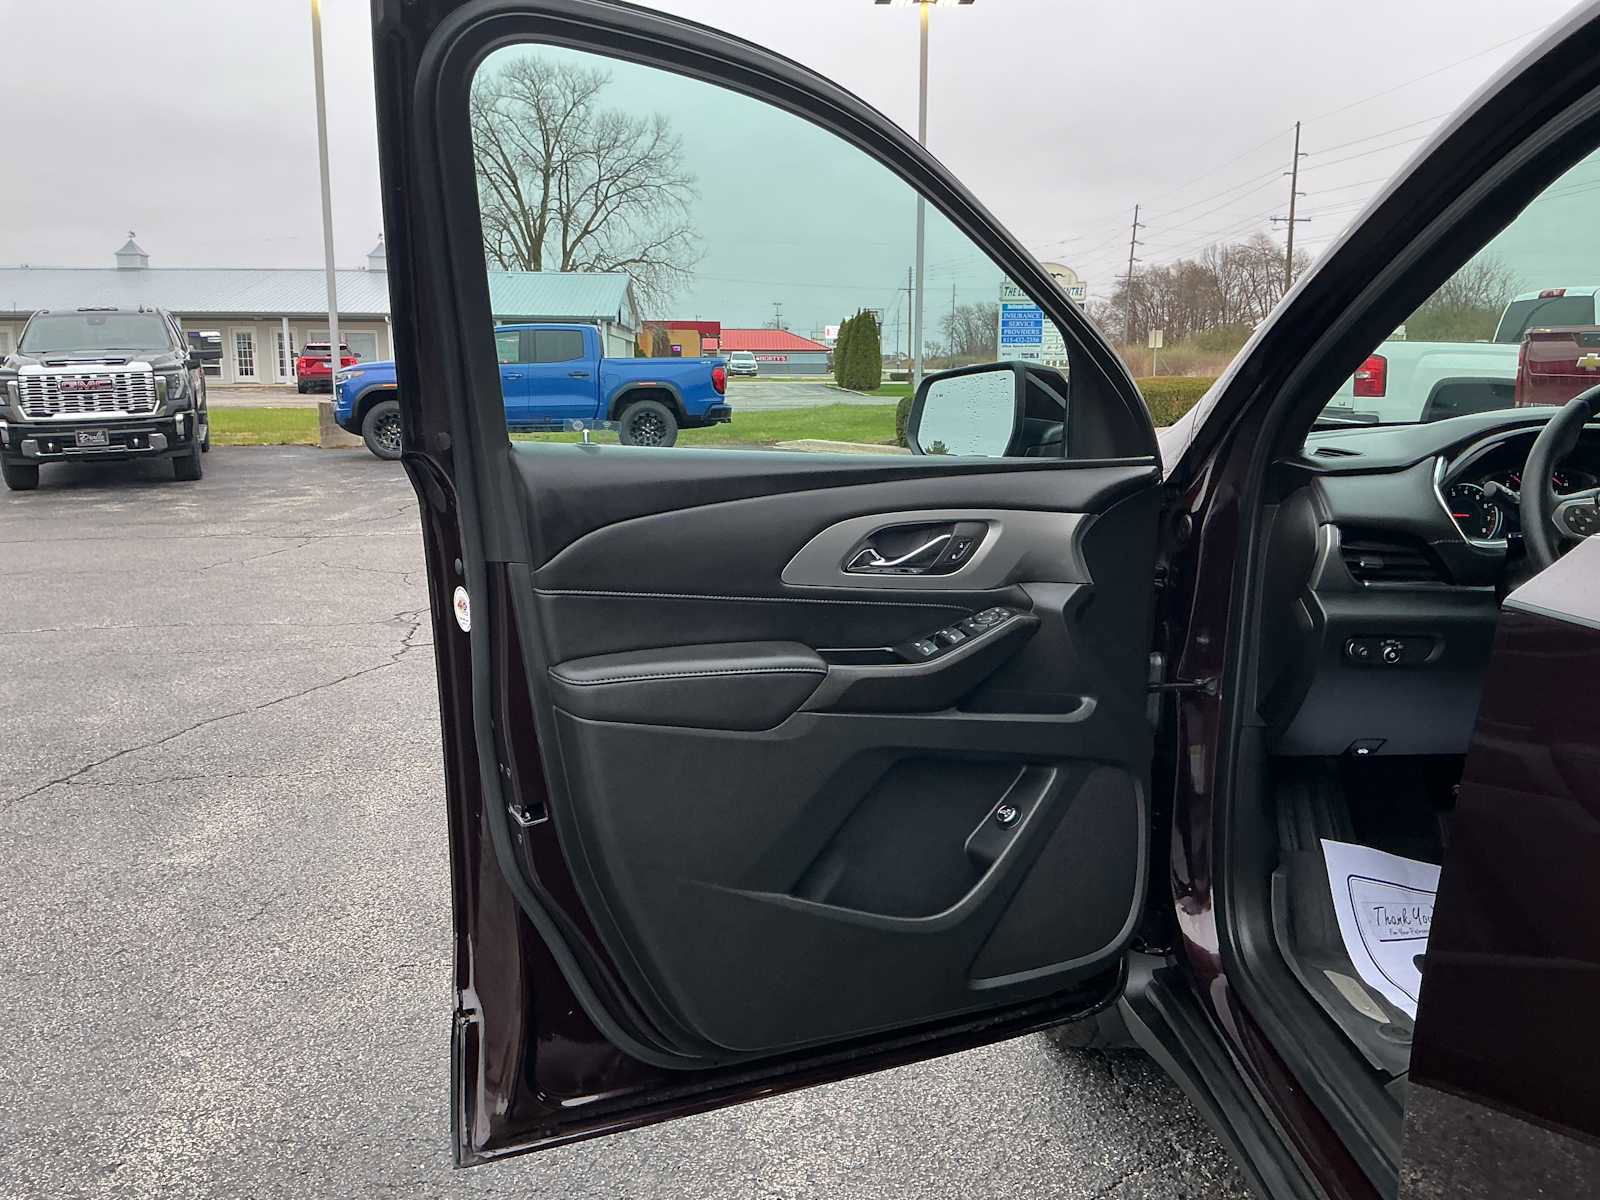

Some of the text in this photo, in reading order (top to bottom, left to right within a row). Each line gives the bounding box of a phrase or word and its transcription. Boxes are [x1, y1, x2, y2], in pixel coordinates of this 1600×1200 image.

[1003, 286, 1017, 297] THE
[1008, 320, 1035, 328] SERVICE
[1003, 328, 1041, 336] PROVIDERS
[60, 379, 112, 391] GMC
[1373, 906, 1412, 927] Thank
